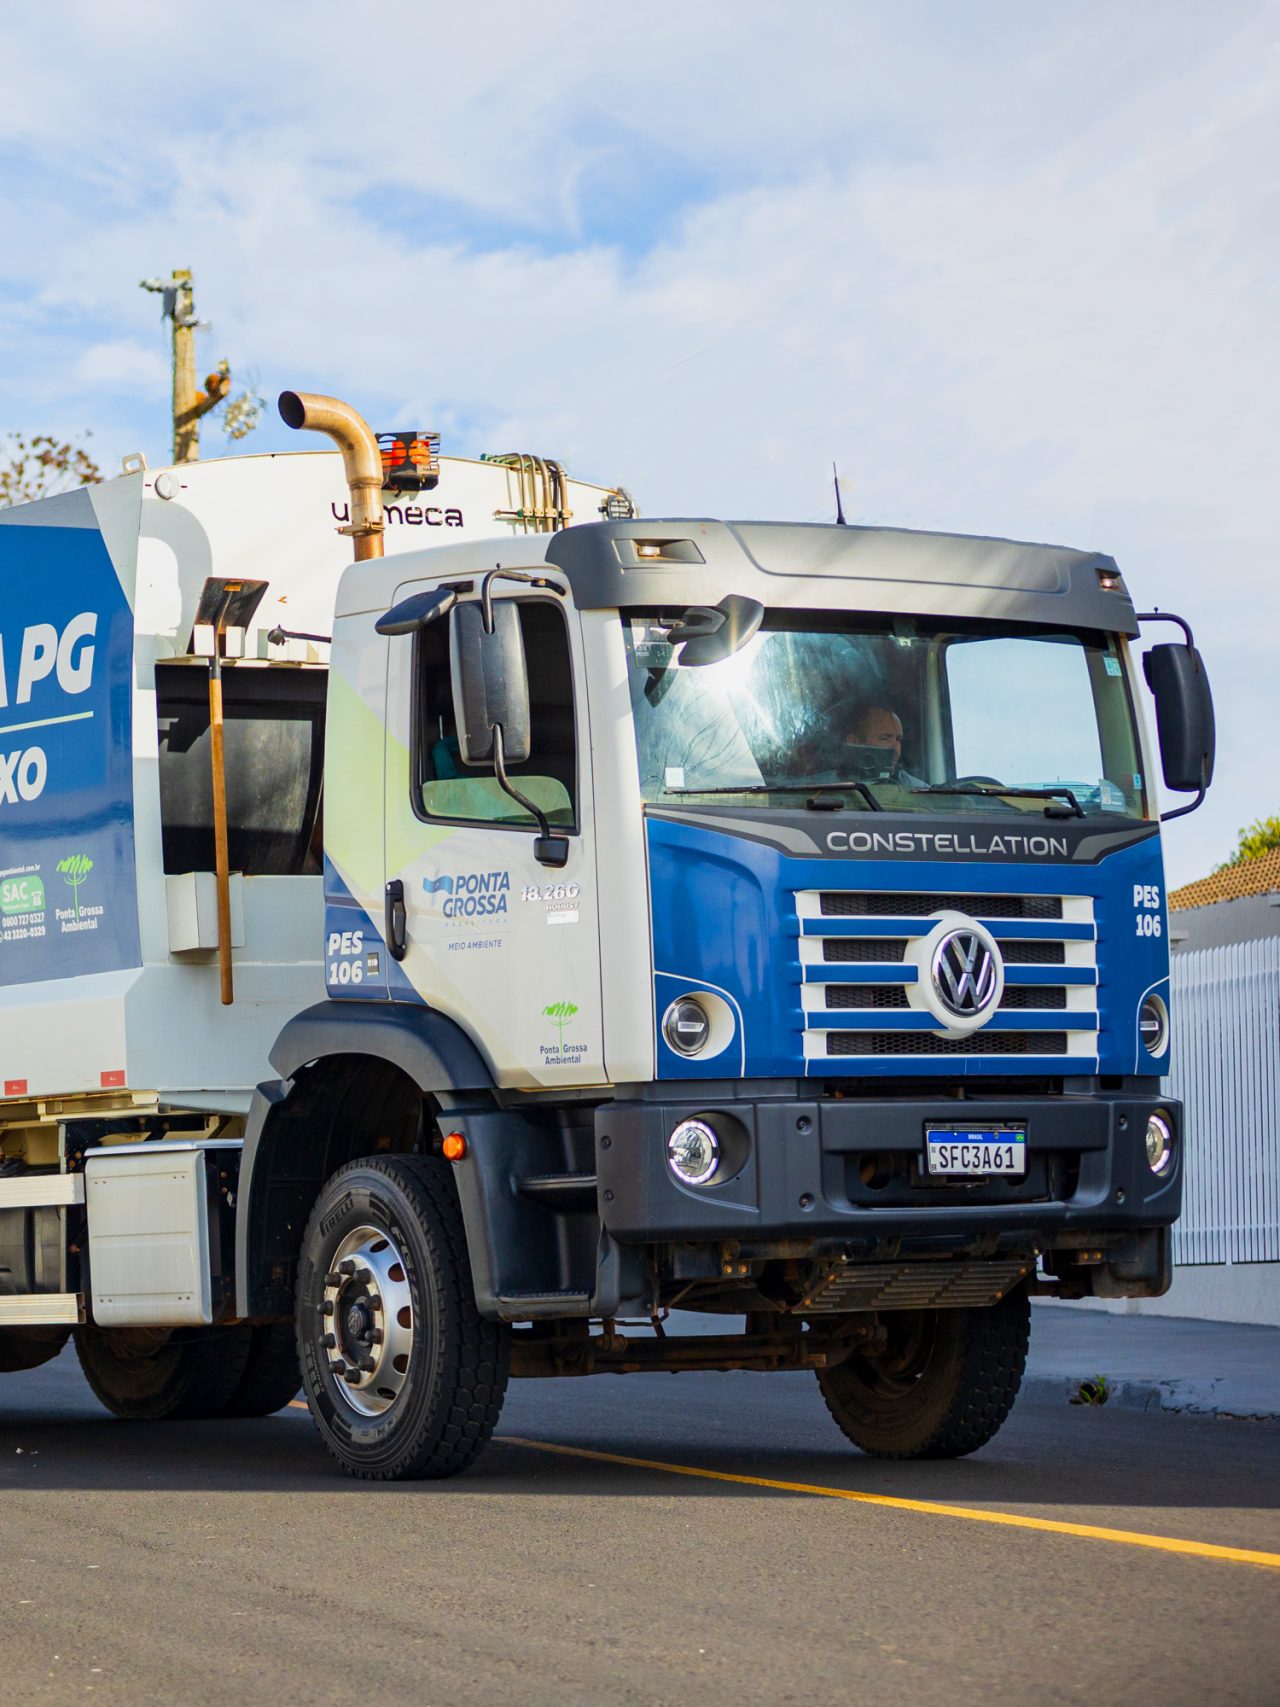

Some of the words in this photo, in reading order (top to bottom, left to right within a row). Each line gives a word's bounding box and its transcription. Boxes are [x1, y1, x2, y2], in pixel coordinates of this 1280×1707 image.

[331, 502, 464, 528] umeca
[16, 611, 98, 704] PG
[826, 831, 1068, 857] CONSTELLATION
[2, 882, 29, 903] SAC
[455, 871, 511, 895] PONTA
[522, 881, 581, 902] 18.260
[443, 893, 508, 918] GROSSA
[1133, 884, 1160, 909] PES
[55, 908, 76, 920] Ponta
[78, 905, 104, 917] Grossa
[61, 918, 98, 933] Ambiental
[1135, 914, 1162, 938] 106
[328, 930, 364, 956] PES
[448, 941, 466, 951] MEIO
[467, 939, 502, 950] AMBIENTE
[329, 960, 363, 985] 106
[539, 1045, 560, 1055] Ponta
[563, 1043, 588, 1053] Grossa
[545, 1054, 581, 1065] Ambiental
[939, 1145, 1015, 1169] SFC3A61
[320, 1191, 354, 1239] PIRELLI
